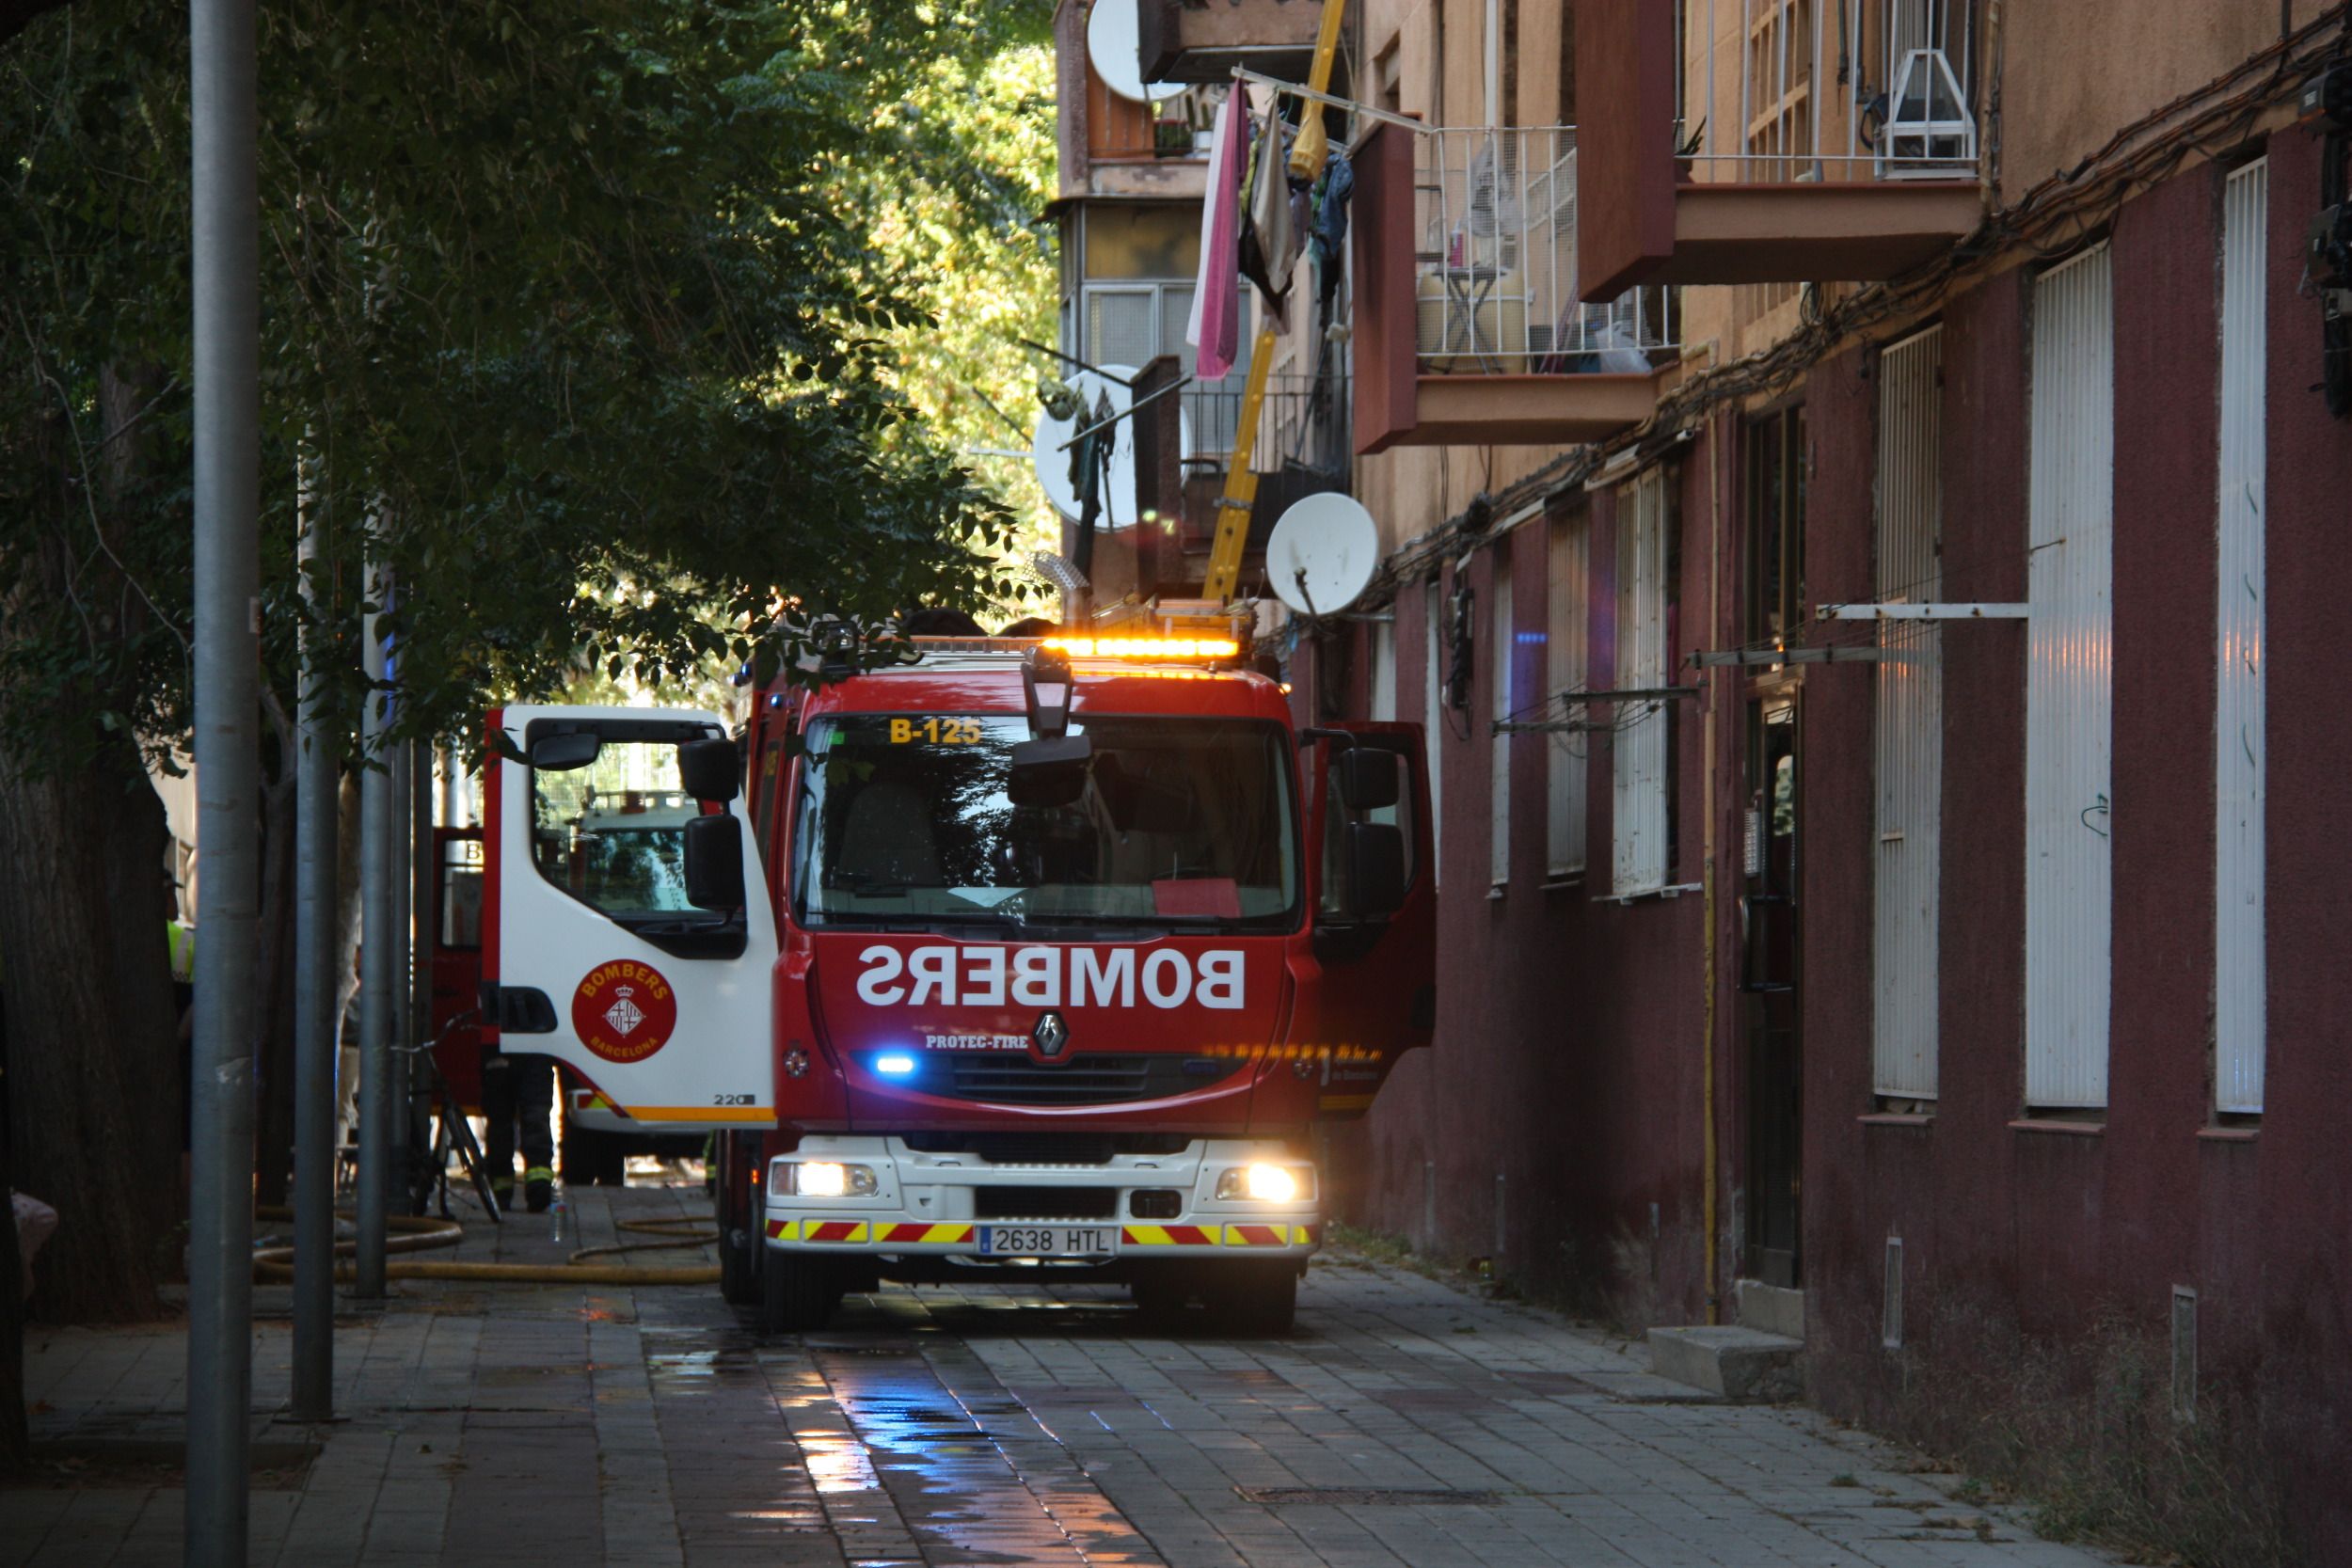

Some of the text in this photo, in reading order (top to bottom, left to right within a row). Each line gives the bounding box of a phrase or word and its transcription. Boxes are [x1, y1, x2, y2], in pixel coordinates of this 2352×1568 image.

[891, 719, 981, 744] B-125
[581, 963, 668, 1000] BOMBERS
[591, 1037, 658, 1057] BARCELONA
[926, 1036, 1029, 1049] PROTEC-FIRE
[995, 1229, 1053, 1251] 2638
[1067, 1230, 1109, 1252] HTL
